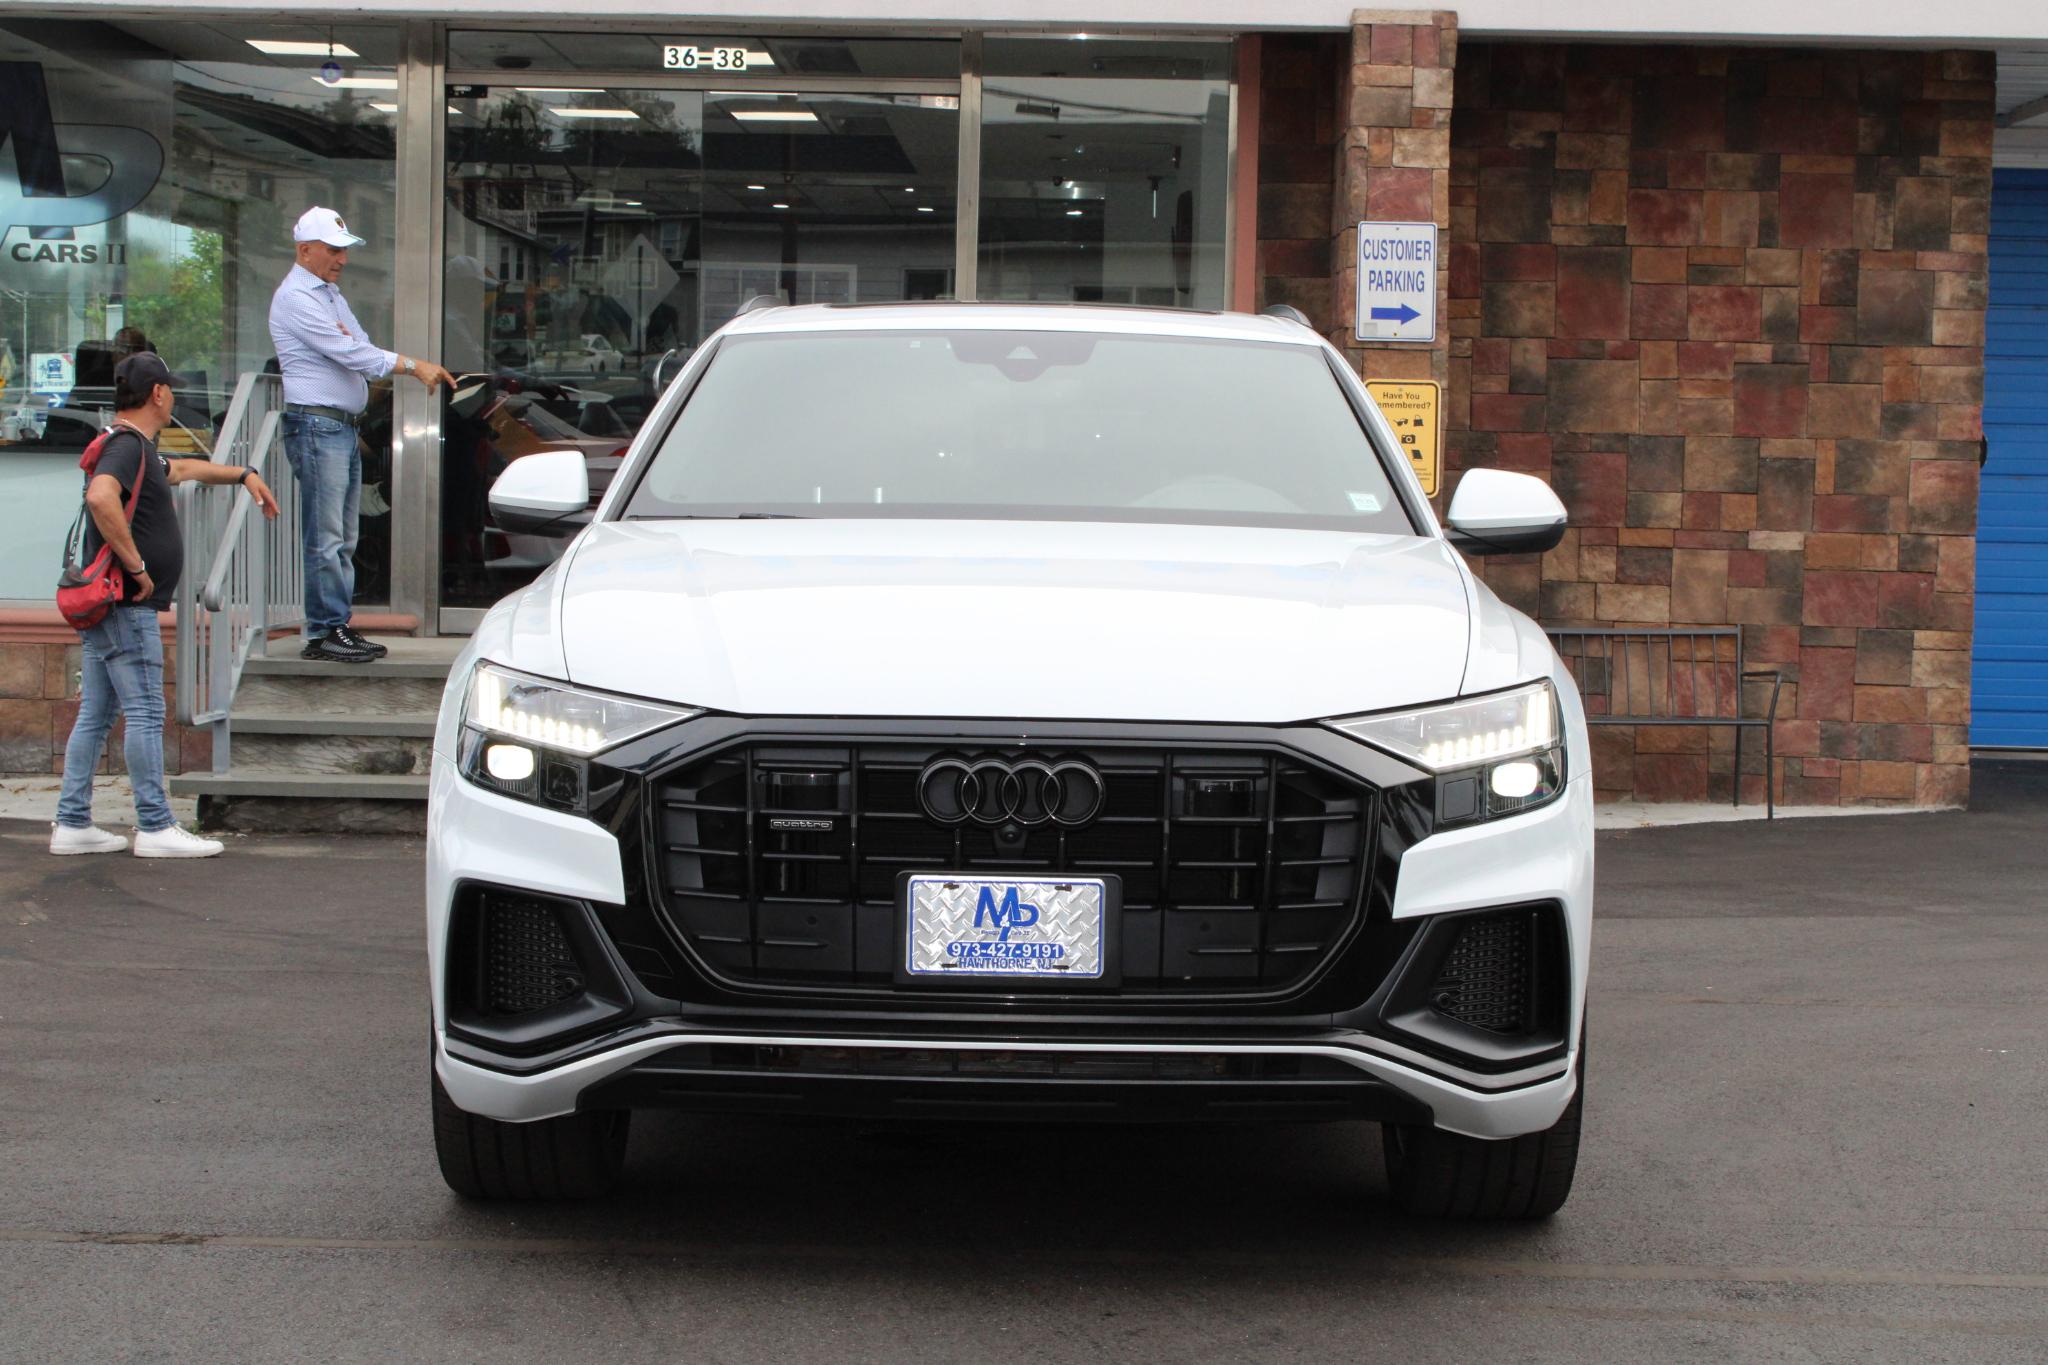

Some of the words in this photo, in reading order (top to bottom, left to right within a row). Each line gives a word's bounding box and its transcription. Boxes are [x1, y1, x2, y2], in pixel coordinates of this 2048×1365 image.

[667, 47, 744, 68] 36-38
[11, 243, 98, 263] CARS
[1363, 238, 1432, 261] CUSTOMER
[1368, 270, 1425, 293] PARKING
[1382, 392, 1403, 400] Have
[1405, 392, 1420, 400] You
[1377, 402, 1432, 410] emembered?
[773, 821, 830, 829] quattro
[951, 942, 1060, 958] 973-427-9191
